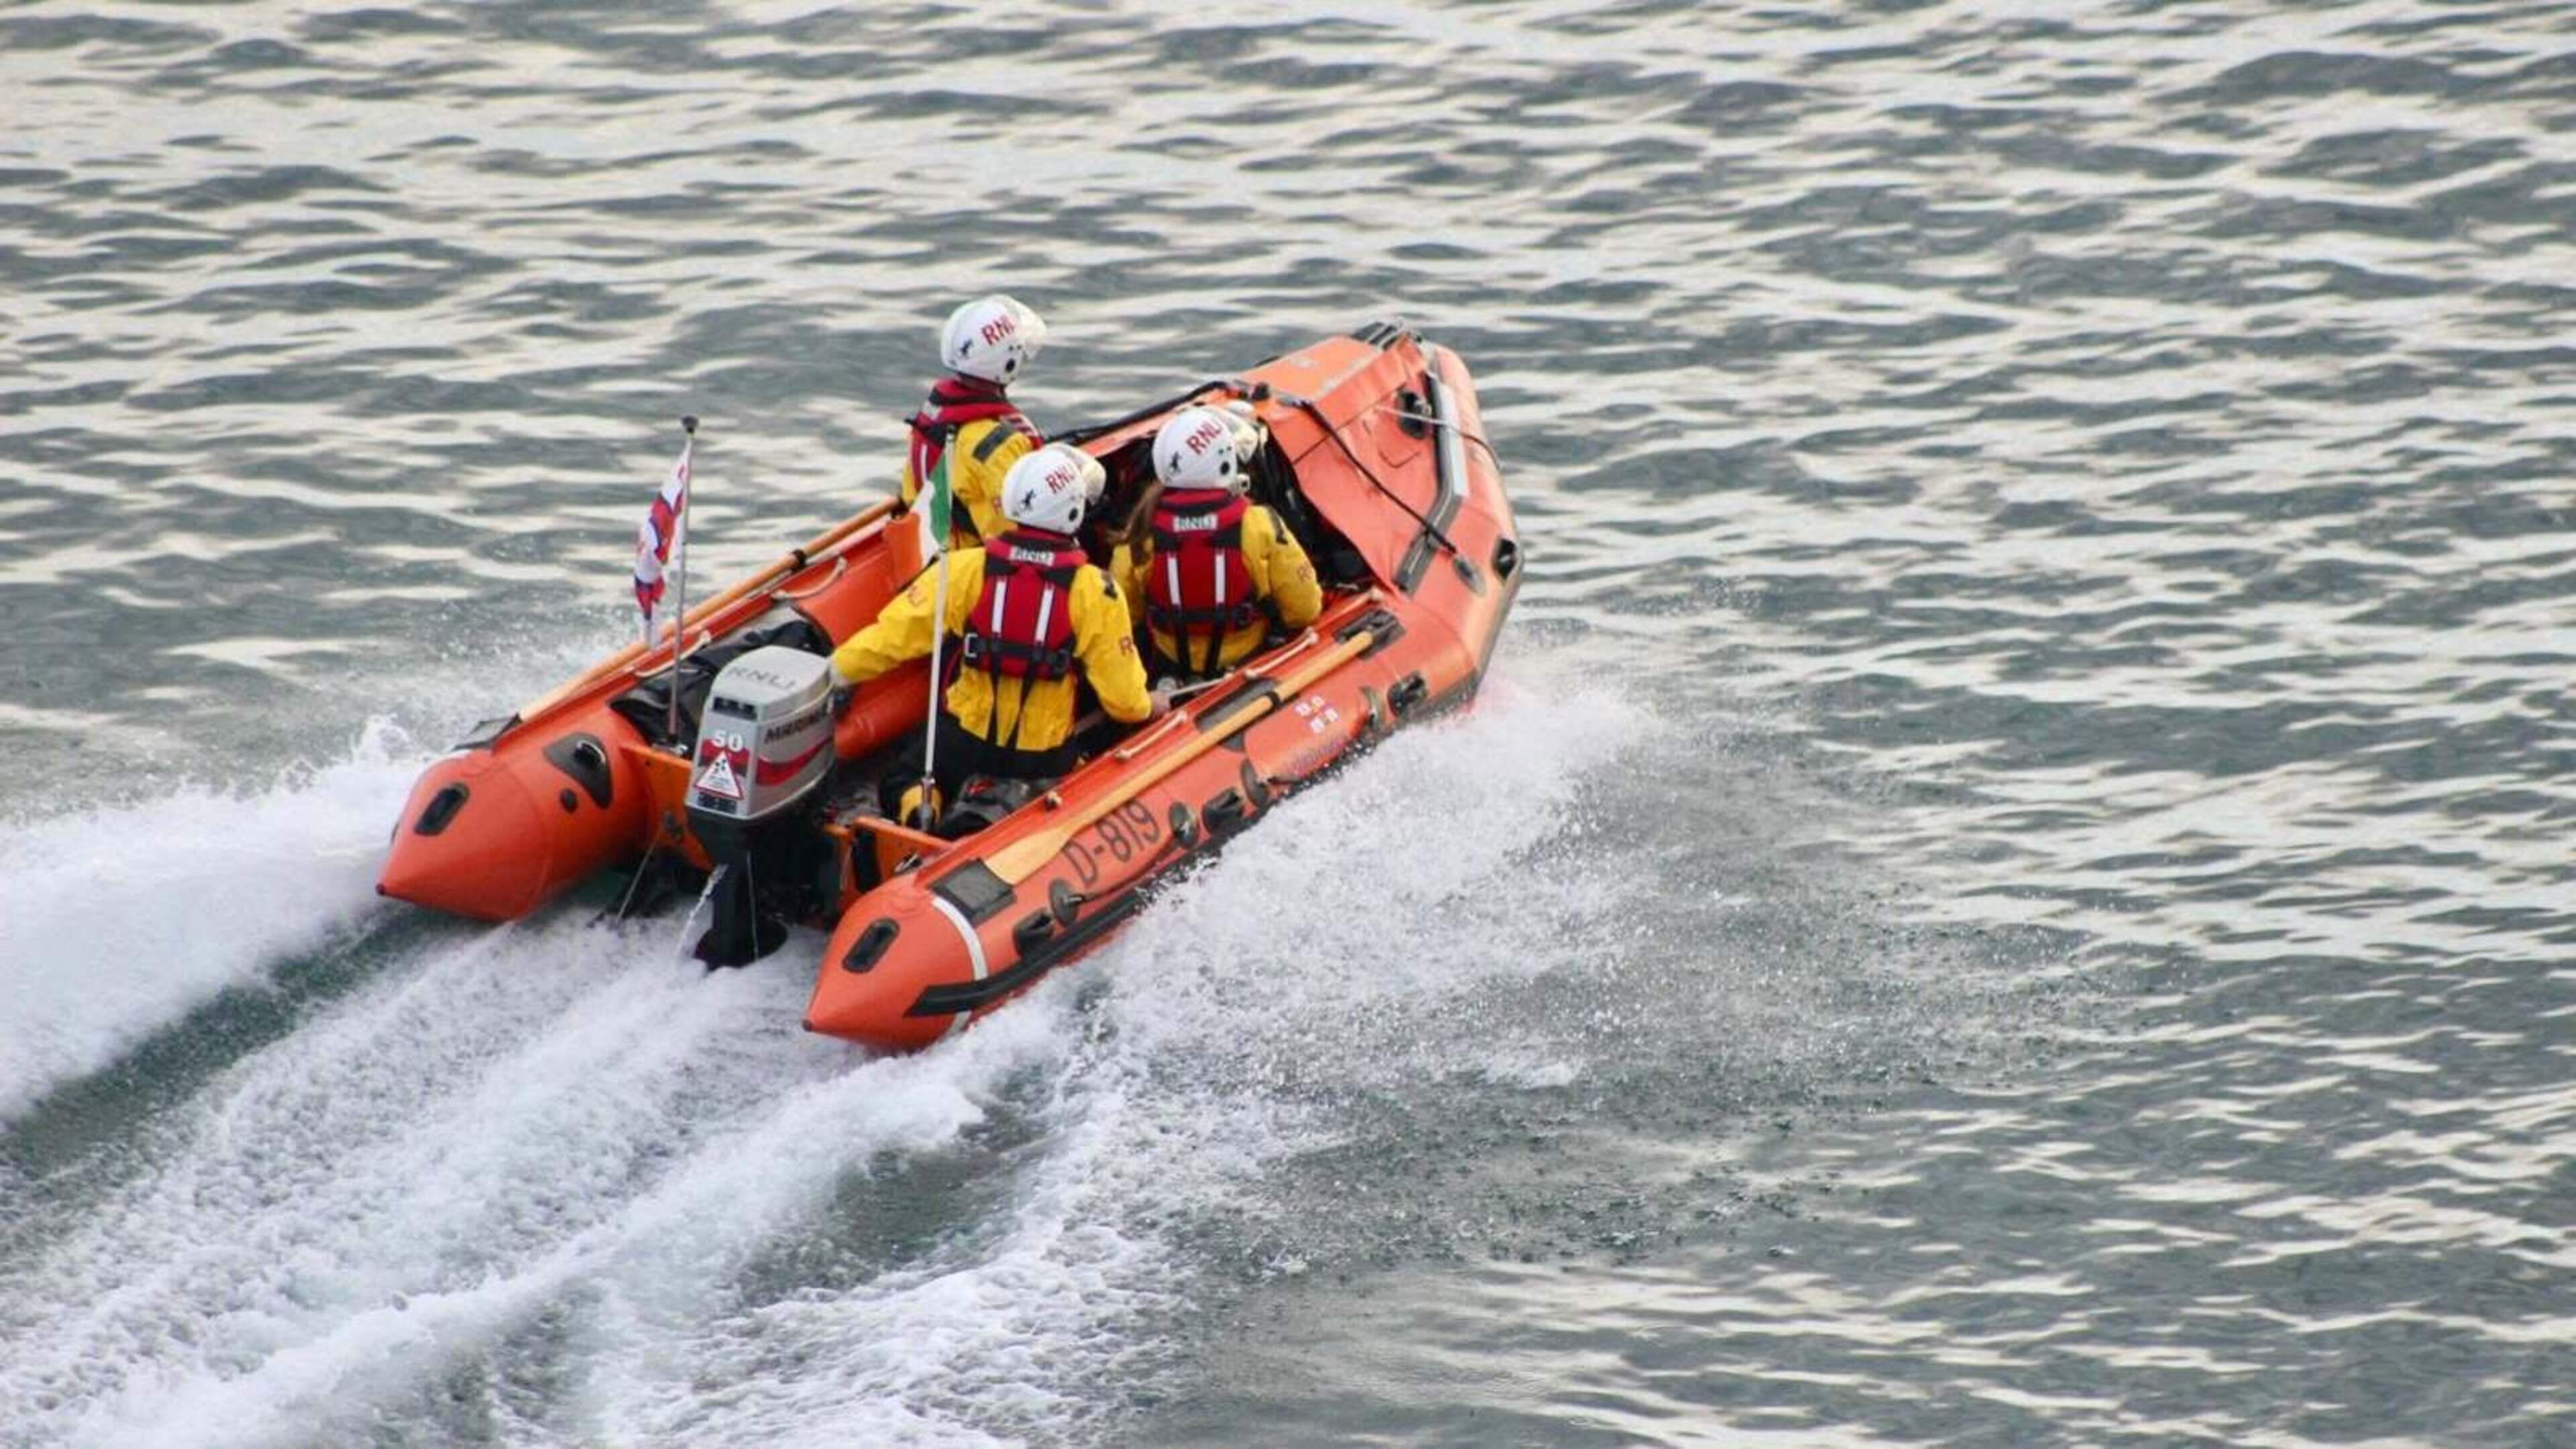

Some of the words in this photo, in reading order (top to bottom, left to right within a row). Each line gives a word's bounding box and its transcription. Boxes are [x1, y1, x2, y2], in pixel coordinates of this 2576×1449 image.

[725, 667, 796, 689] RNLI
[712, 729, 744, 752] 50
[1061, 798, 1161, 887] D-819
